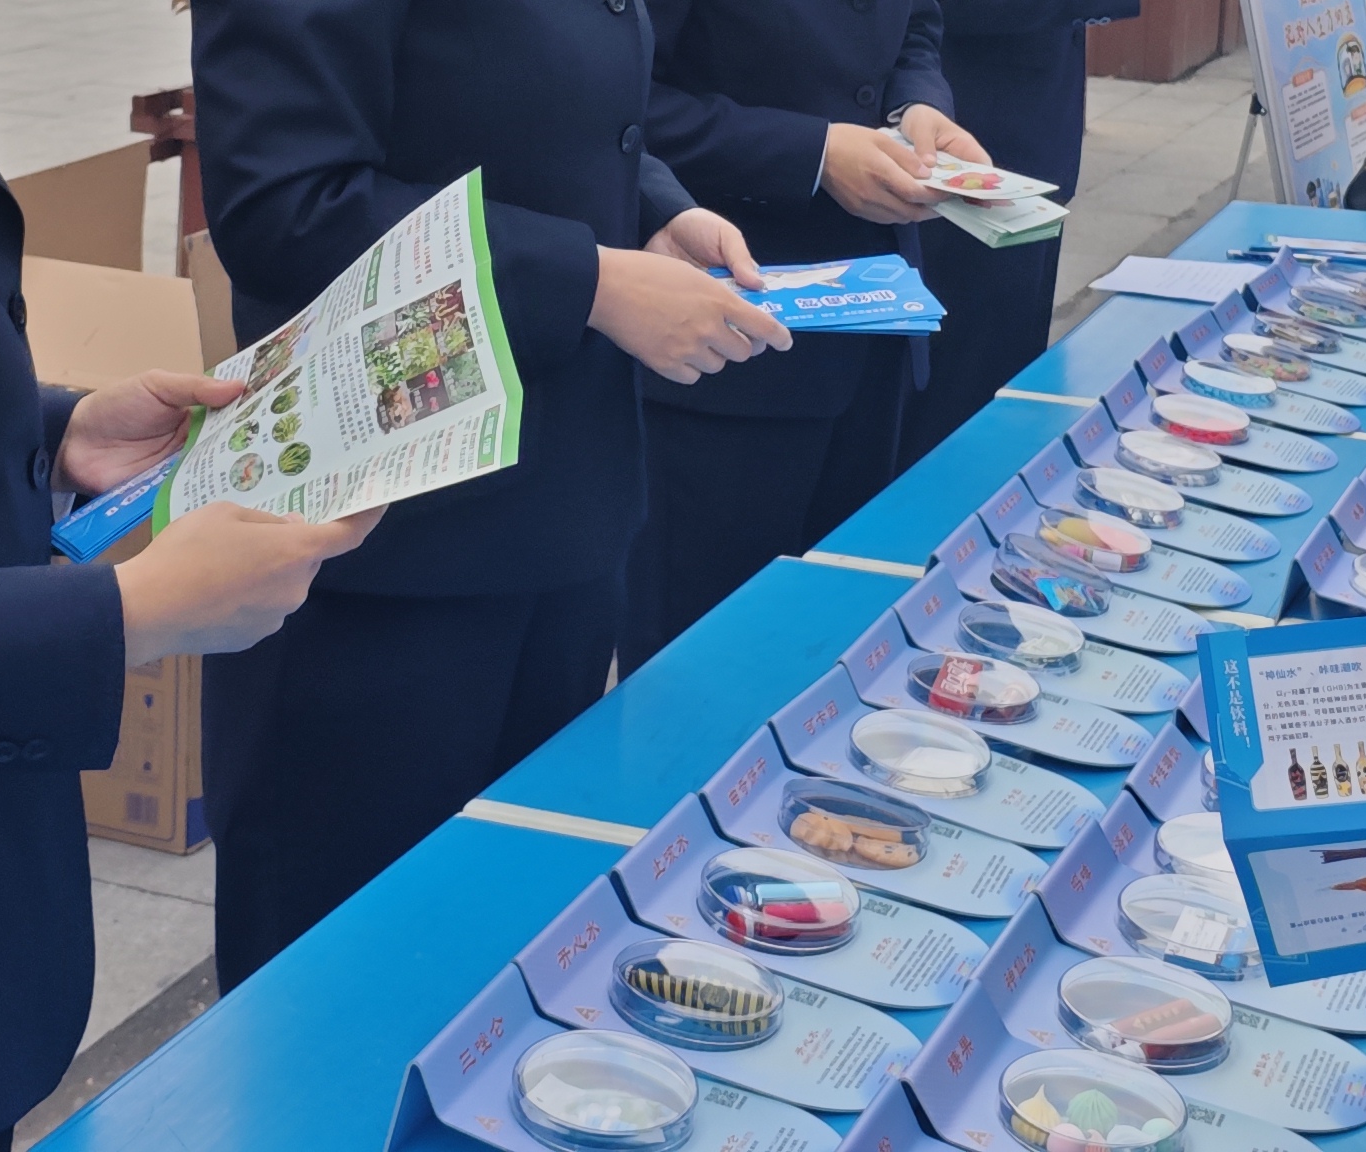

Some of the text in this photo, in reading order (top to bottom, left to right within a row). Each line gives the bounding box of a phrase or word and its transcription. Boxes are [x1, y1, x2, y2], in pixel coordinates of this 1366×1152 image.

[556, 920, 602, 971] 开心水
[1004, 942, 1036, 992] 神仙水
[459, 1016, 506, 1075] 三唑仑
